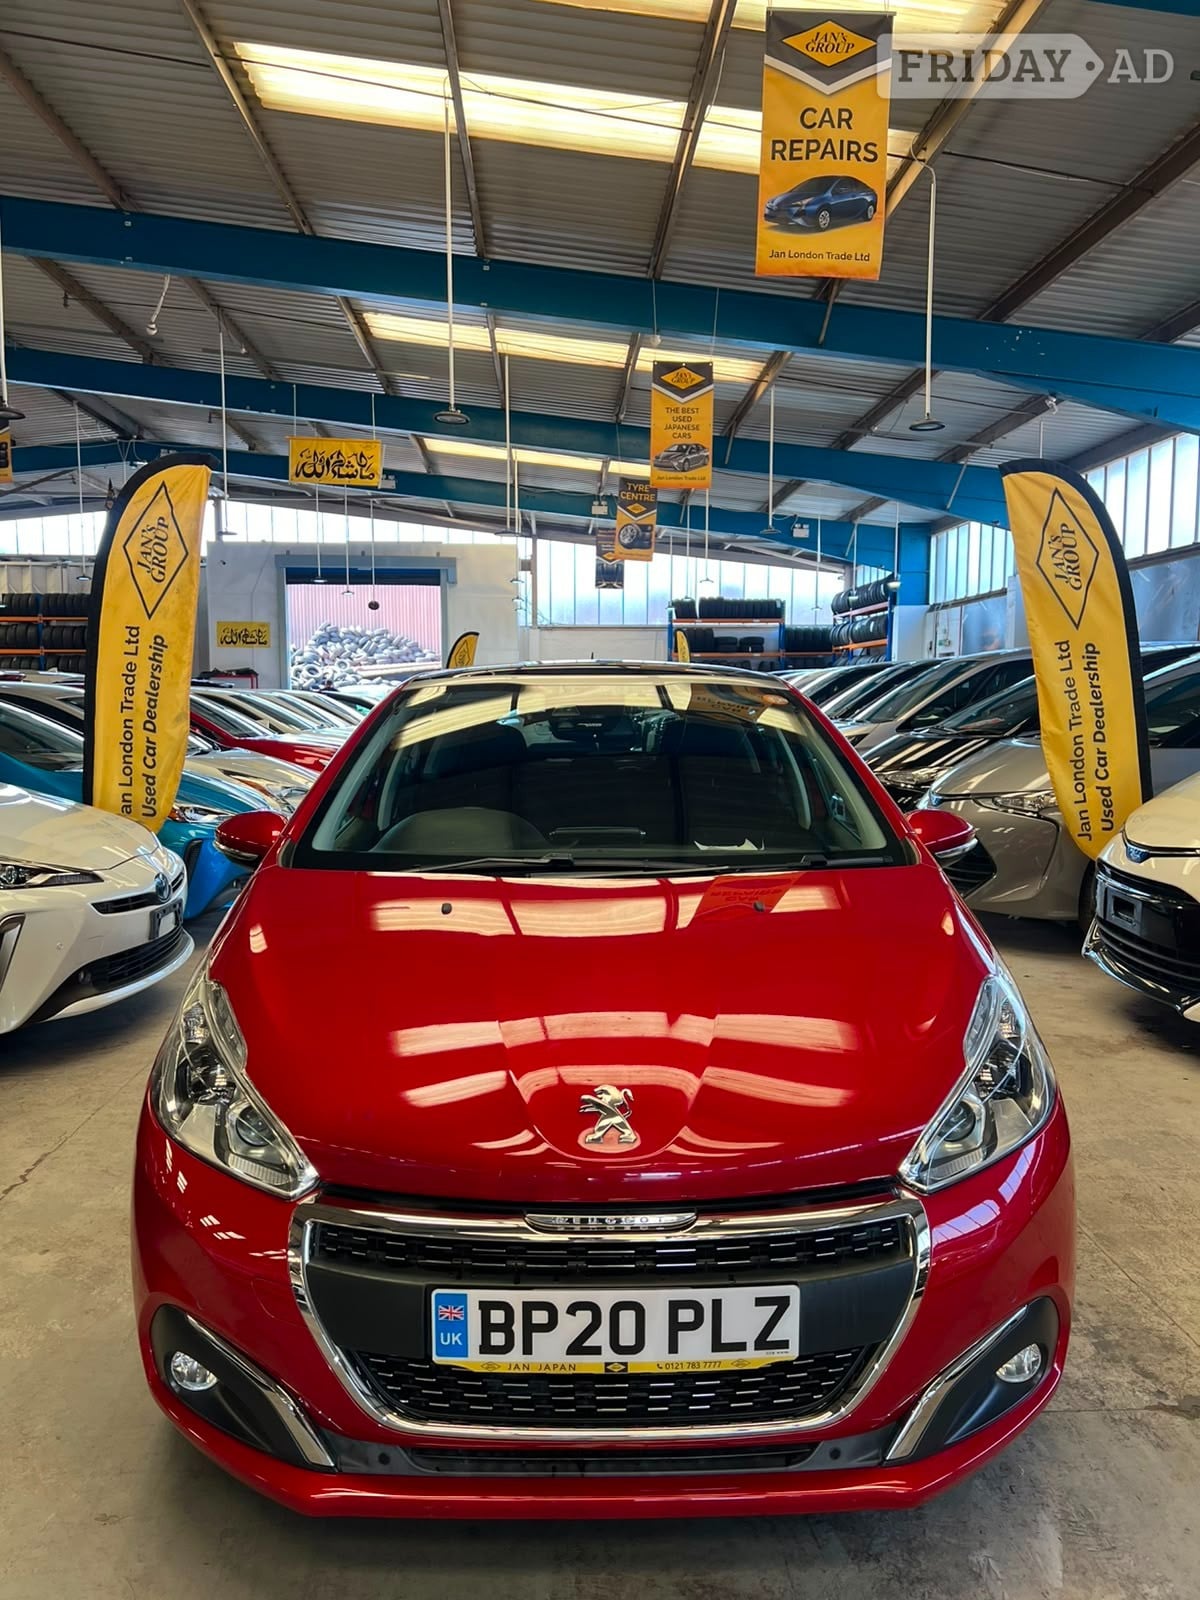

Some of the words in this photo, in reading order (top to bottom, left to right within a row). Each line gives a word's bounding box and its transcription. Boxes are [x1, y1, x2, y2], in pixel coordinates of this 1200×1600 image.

[805, 41, 855, 53] GROUP
[799, 107, 853, 130] CAR
[770, 138, 879, 163] REPAIRS
[769, 249, 786, 259] Jan
[788, 249, 824, 260] London
[826, 251, 853, 261] Trade
[854, 252, 870, 262] Ltd
[672, 415, 693, 423] USED
[620, 491, 656, 502] CENTRE
[627, 482, 650, 493] TYRE
[151, 516, 170, 583] GROUP
[1060, 522, 1083, 591] GROUP
[125, 625, 140, 656] Ltd
[1054, 640, 1073, 672] Ltd
[120, 661, 137, 713] Trade
[143, 634, 168, 733] Dealership
[1082, 642, 1107, 743] Dealership
[1064, 677, 1083, 731] Trade
[119, 718, 134, 787] London
[143, 738, 157, 770] Car
[1095, 748, 1109, 781] Car
[1069, 734, 1087, 805] London
[120, 792, 133, 816] an
[142, 772, 157, 818] Used
[1096, 785, 1115, 832] Used
[1077, 809, 1092, 841] Jan
[440, 1332, 463, 1346] UK
[478, 1300, 646, 1356] BP20
[668, 1295, 791, 1355] PLZ
[537, 1363, 576, 1371] JAPAN
[665, 1362, 684, 1370] 0121
[686, 1361, 701, 1370] 783
[703, 1360, 722, 1369] 7777
